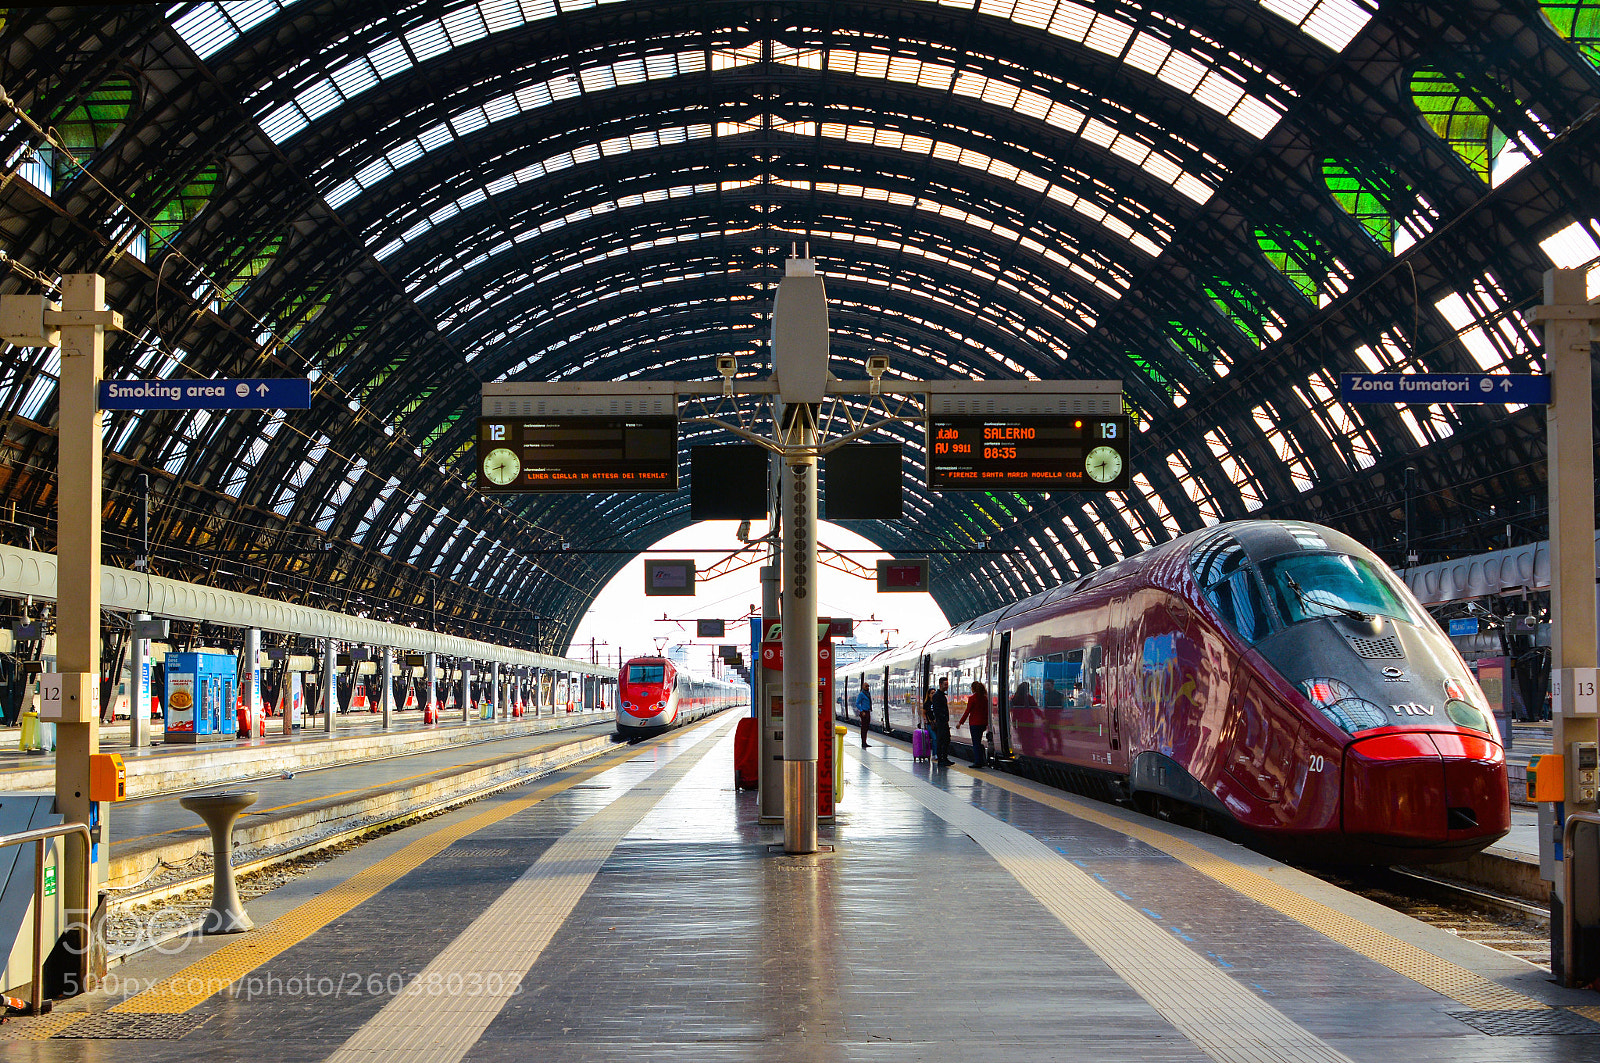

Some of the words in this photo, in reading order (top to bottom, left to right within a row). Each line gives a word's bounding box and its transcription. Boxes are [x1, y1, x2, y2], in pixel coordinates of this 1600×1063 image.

[1351, 377, 1394, 391] Zona
[1399, 377, 1470, 391] fumatori
[108, 383, 182, 400] Smoking
[186, 386, 225, 397] area
[489, 424, 506, 441] 12
[983, 427, 1036, 440] SALERNO
[1100, 422, 1117, 439] 13
[935, 442, 949, 454] AV
[952, 443, 972, 453] 9911
[983, 447, 1017, 459] 08:35
[43, 687, 60, 701] 12
[1577, 682, 1595, 696] 13
[1389, 702, 1435, 716] ntv
[820, 720, 832, 778] Service
[1309, 755, 1324, 772] 20
[820, 783, 832, 813] Self
